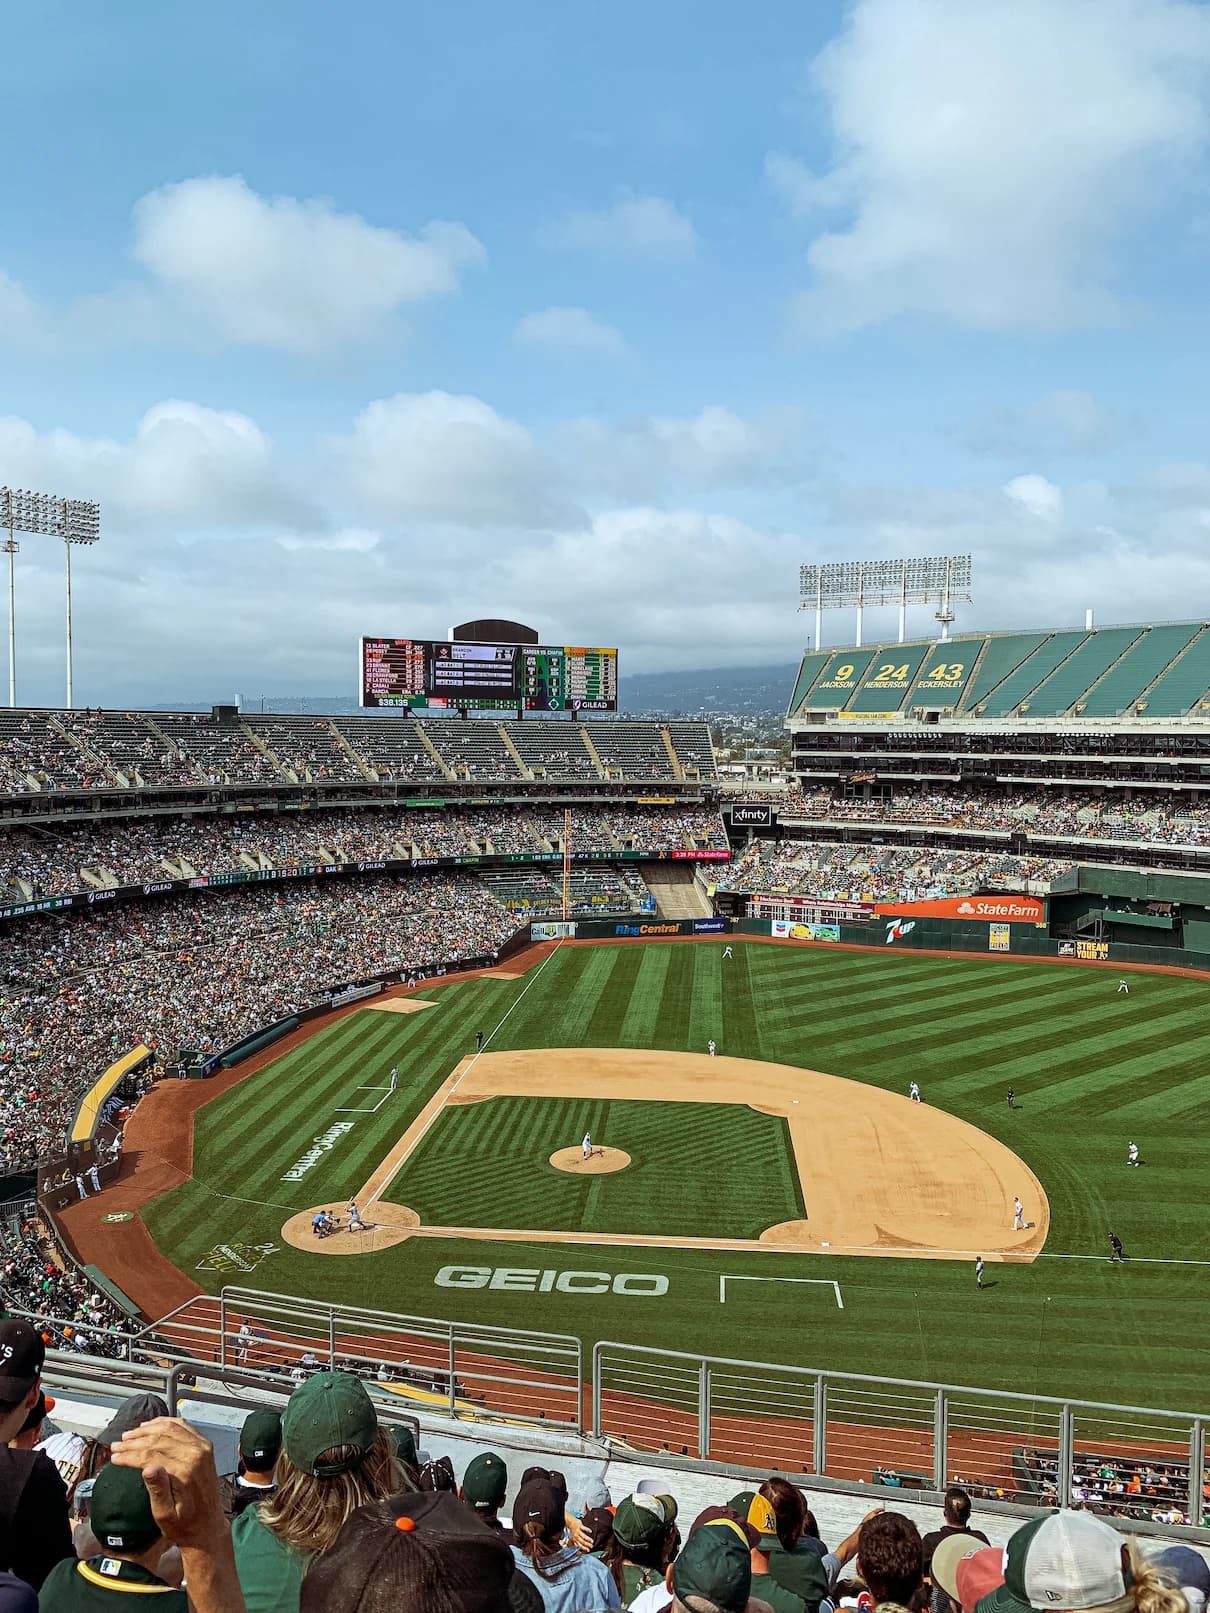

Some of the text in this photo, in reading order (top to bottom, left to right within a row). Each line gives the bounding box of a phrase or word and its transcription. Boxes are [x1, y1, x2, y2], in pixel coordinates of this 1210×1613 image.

[835, 664, 854, 680] 9
[874, 664, 910, 681] 24
[928, 664, 964, 680] 43
[735, 809, 768, 821] xfinity
[151, 883, 172, 892] GILEAD
[95, 891, 116, 900] GILEAD
[532, 927, 544, 936] Call
[616, 924, 678, 936] RingCentral
[1077, 942, 1108, 952] STREAM
[1077, 950, 1096, 960] YOUR
[280, 1122, 355, 1182] RingCentral
[434, 1266, 670, 1296] GEICO
